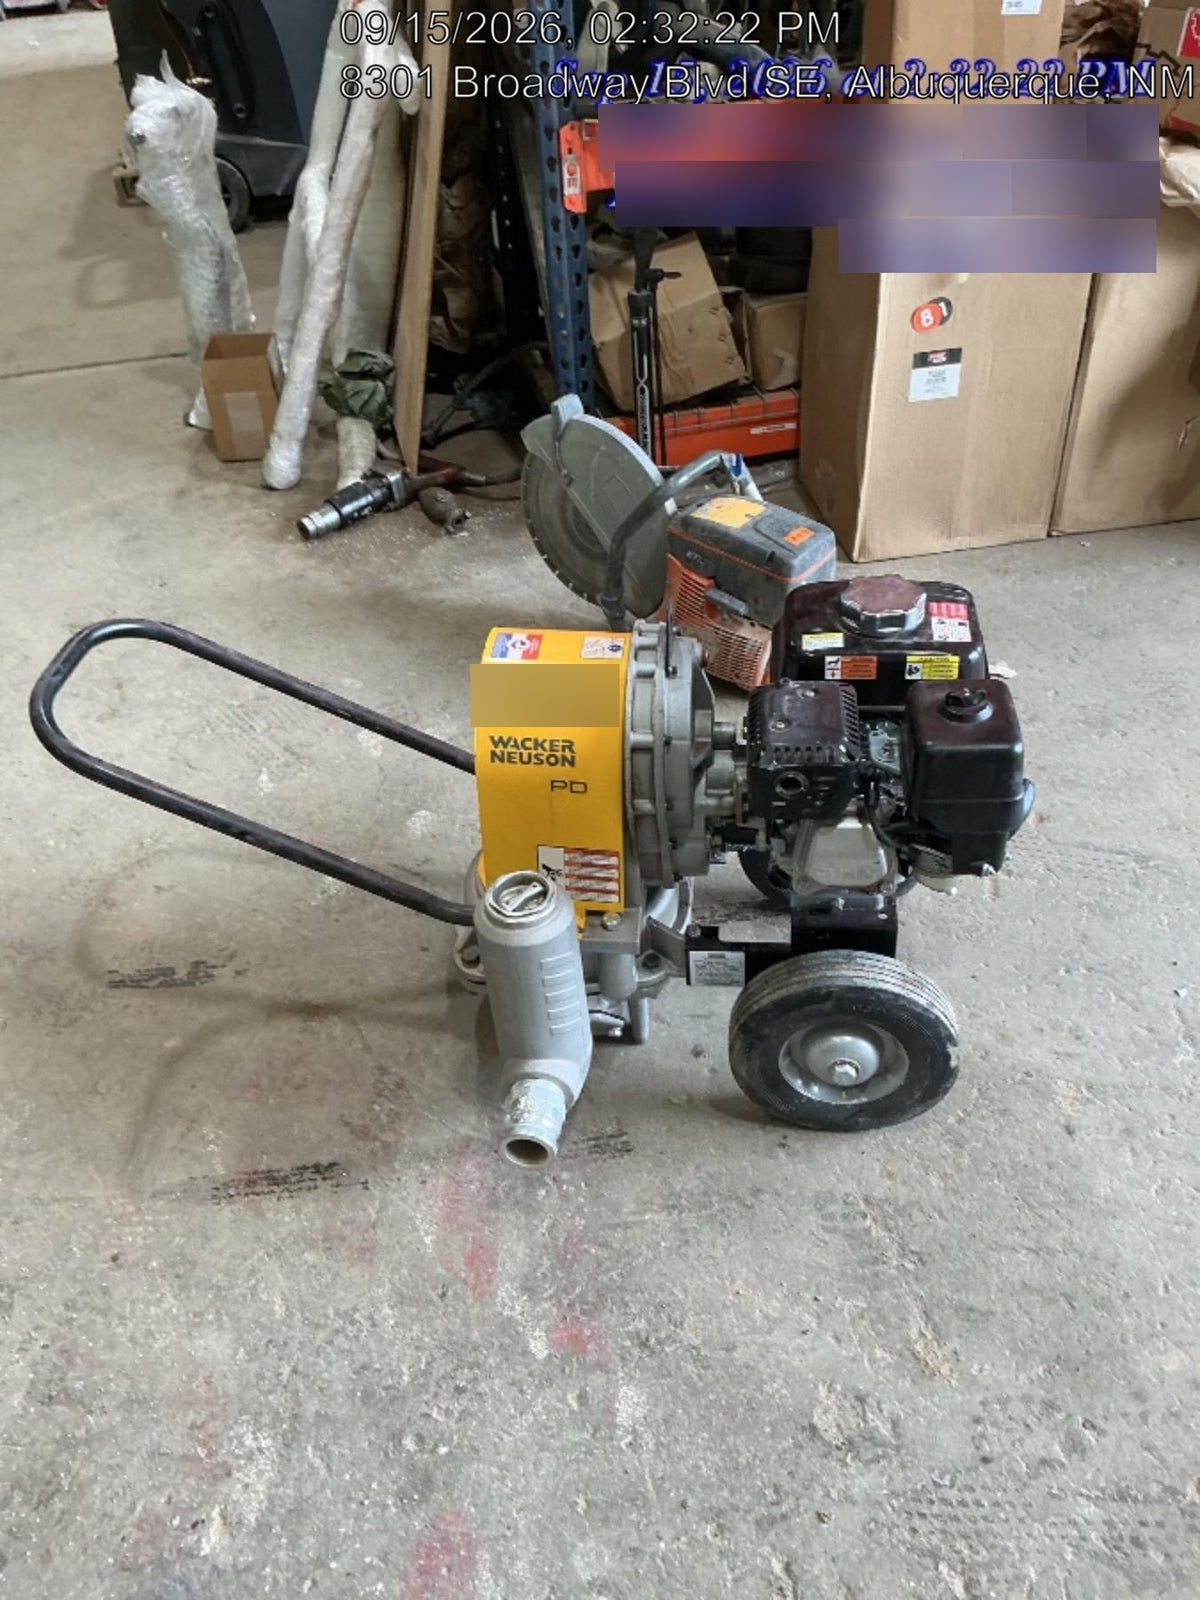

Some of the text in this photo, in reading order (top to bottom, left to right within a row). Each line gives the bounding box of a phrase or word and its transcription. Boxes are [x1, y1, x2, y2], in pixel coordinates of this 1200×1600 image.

[489, 735, 576, 754] WACKER
[490, 750, 576, 768] NEUSON
[550, 779, 588, 794] PD
